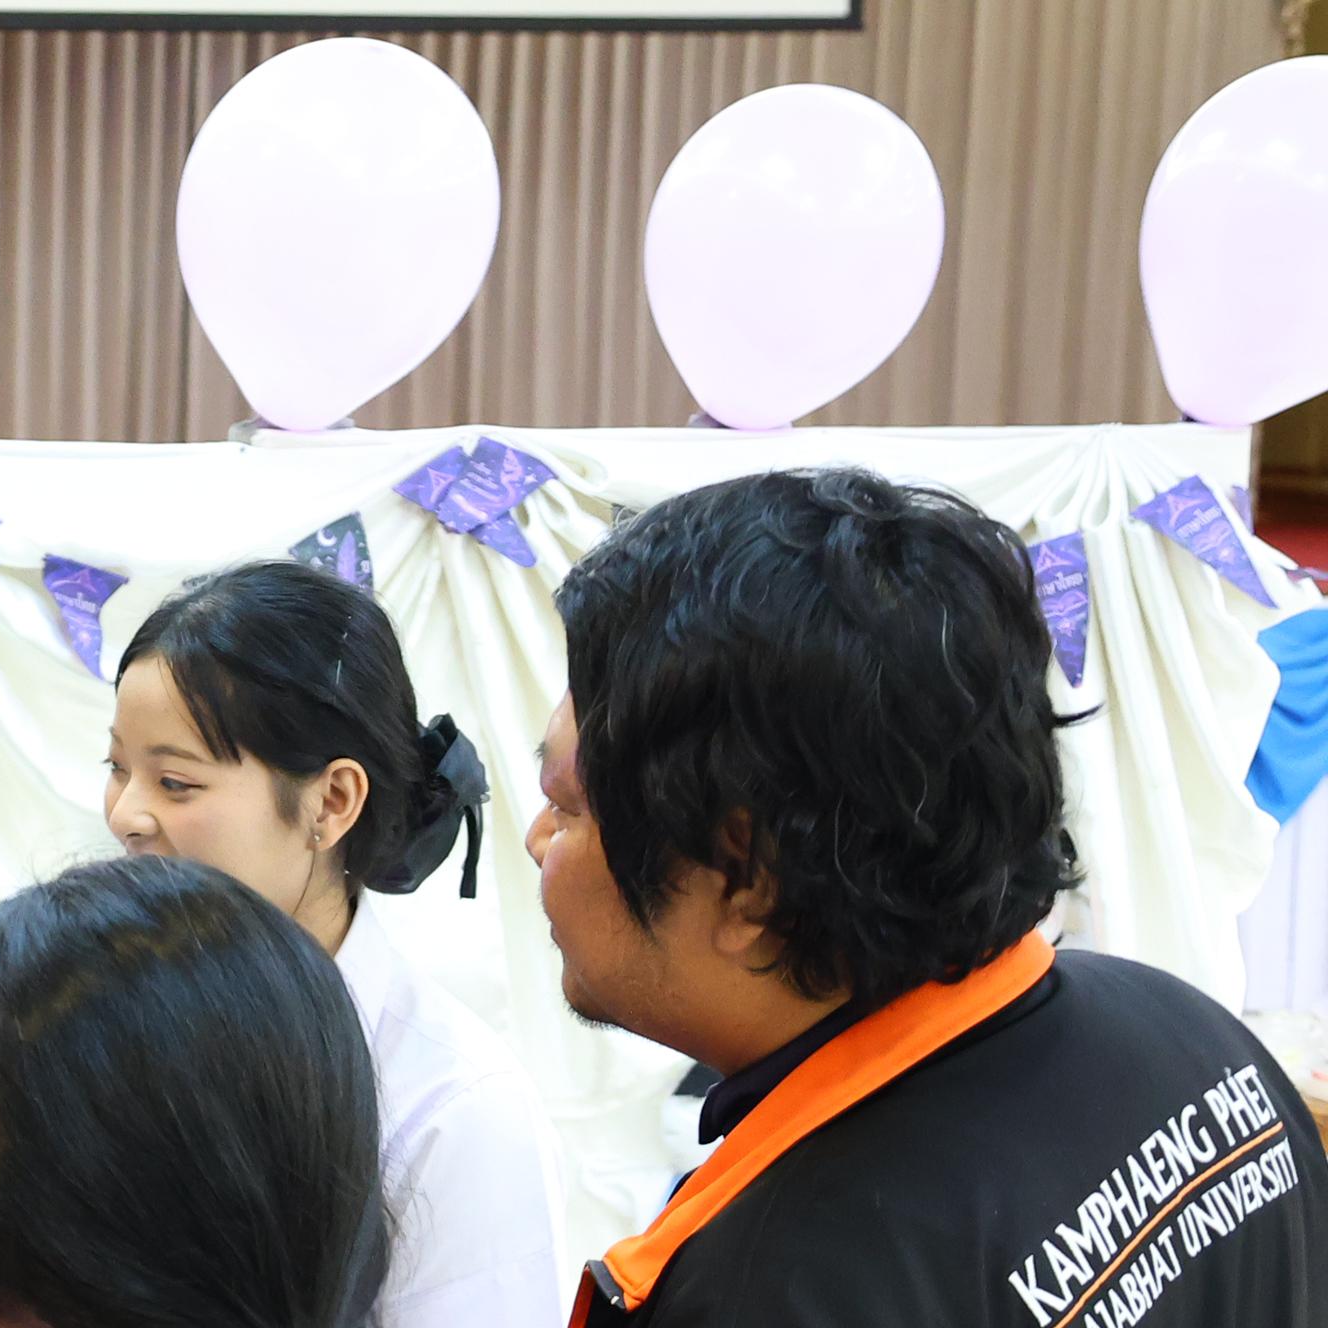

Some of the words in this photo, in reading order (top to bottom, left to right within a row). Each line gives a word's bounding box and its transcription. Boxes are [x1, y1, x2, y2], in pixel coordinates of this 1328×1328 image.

[1007, 1103, 1217, 1328] KAMPHAENG
[1202, 1063, 1278, 1147] PHET
[1177, 1136, 1299, 1258] UNIVERSITY
